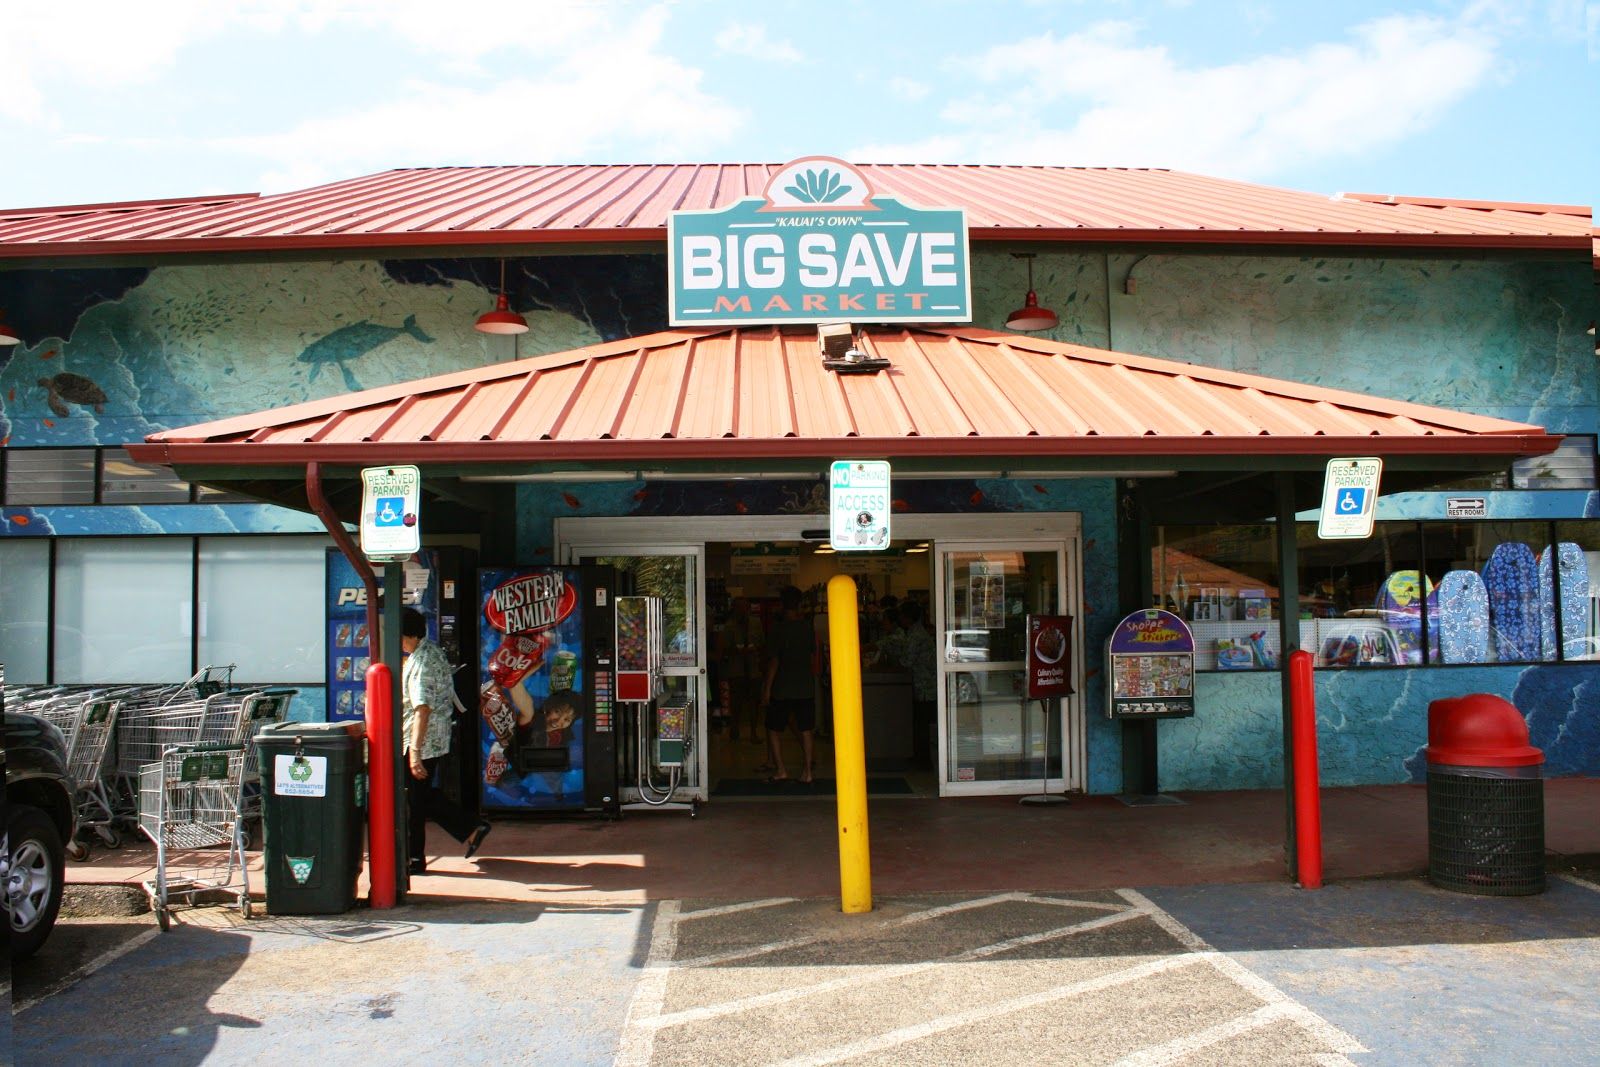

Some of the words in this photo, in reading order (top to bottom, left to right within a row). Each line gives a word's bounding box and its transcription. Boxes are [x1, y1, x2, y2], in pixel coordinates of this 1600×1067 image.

[827, 216, 863, 227] OWN"
[682, 234, 786, 290] BIG
[799, 232, 958, 288] SAVE
[712, 293, 929, 313] MARKET
[367, 473, 415, 486] RESERVED
[833, 467, 850, 485] NO
[851, 470, 886, 481] PARKING
[1331, 465, 1377, 476] RESERVED
[373, 485, 410, 496] PARKING
[1334, 476, 1371, 487] PARKING
[837, 495, 885, 511] ACCESS
[337, 587, 425, 606] PESI
[493, 570, 565, 612] WESTERN
[504, 597, 556, 635] FAMILY
[496, 648, 533, 671] Cola
